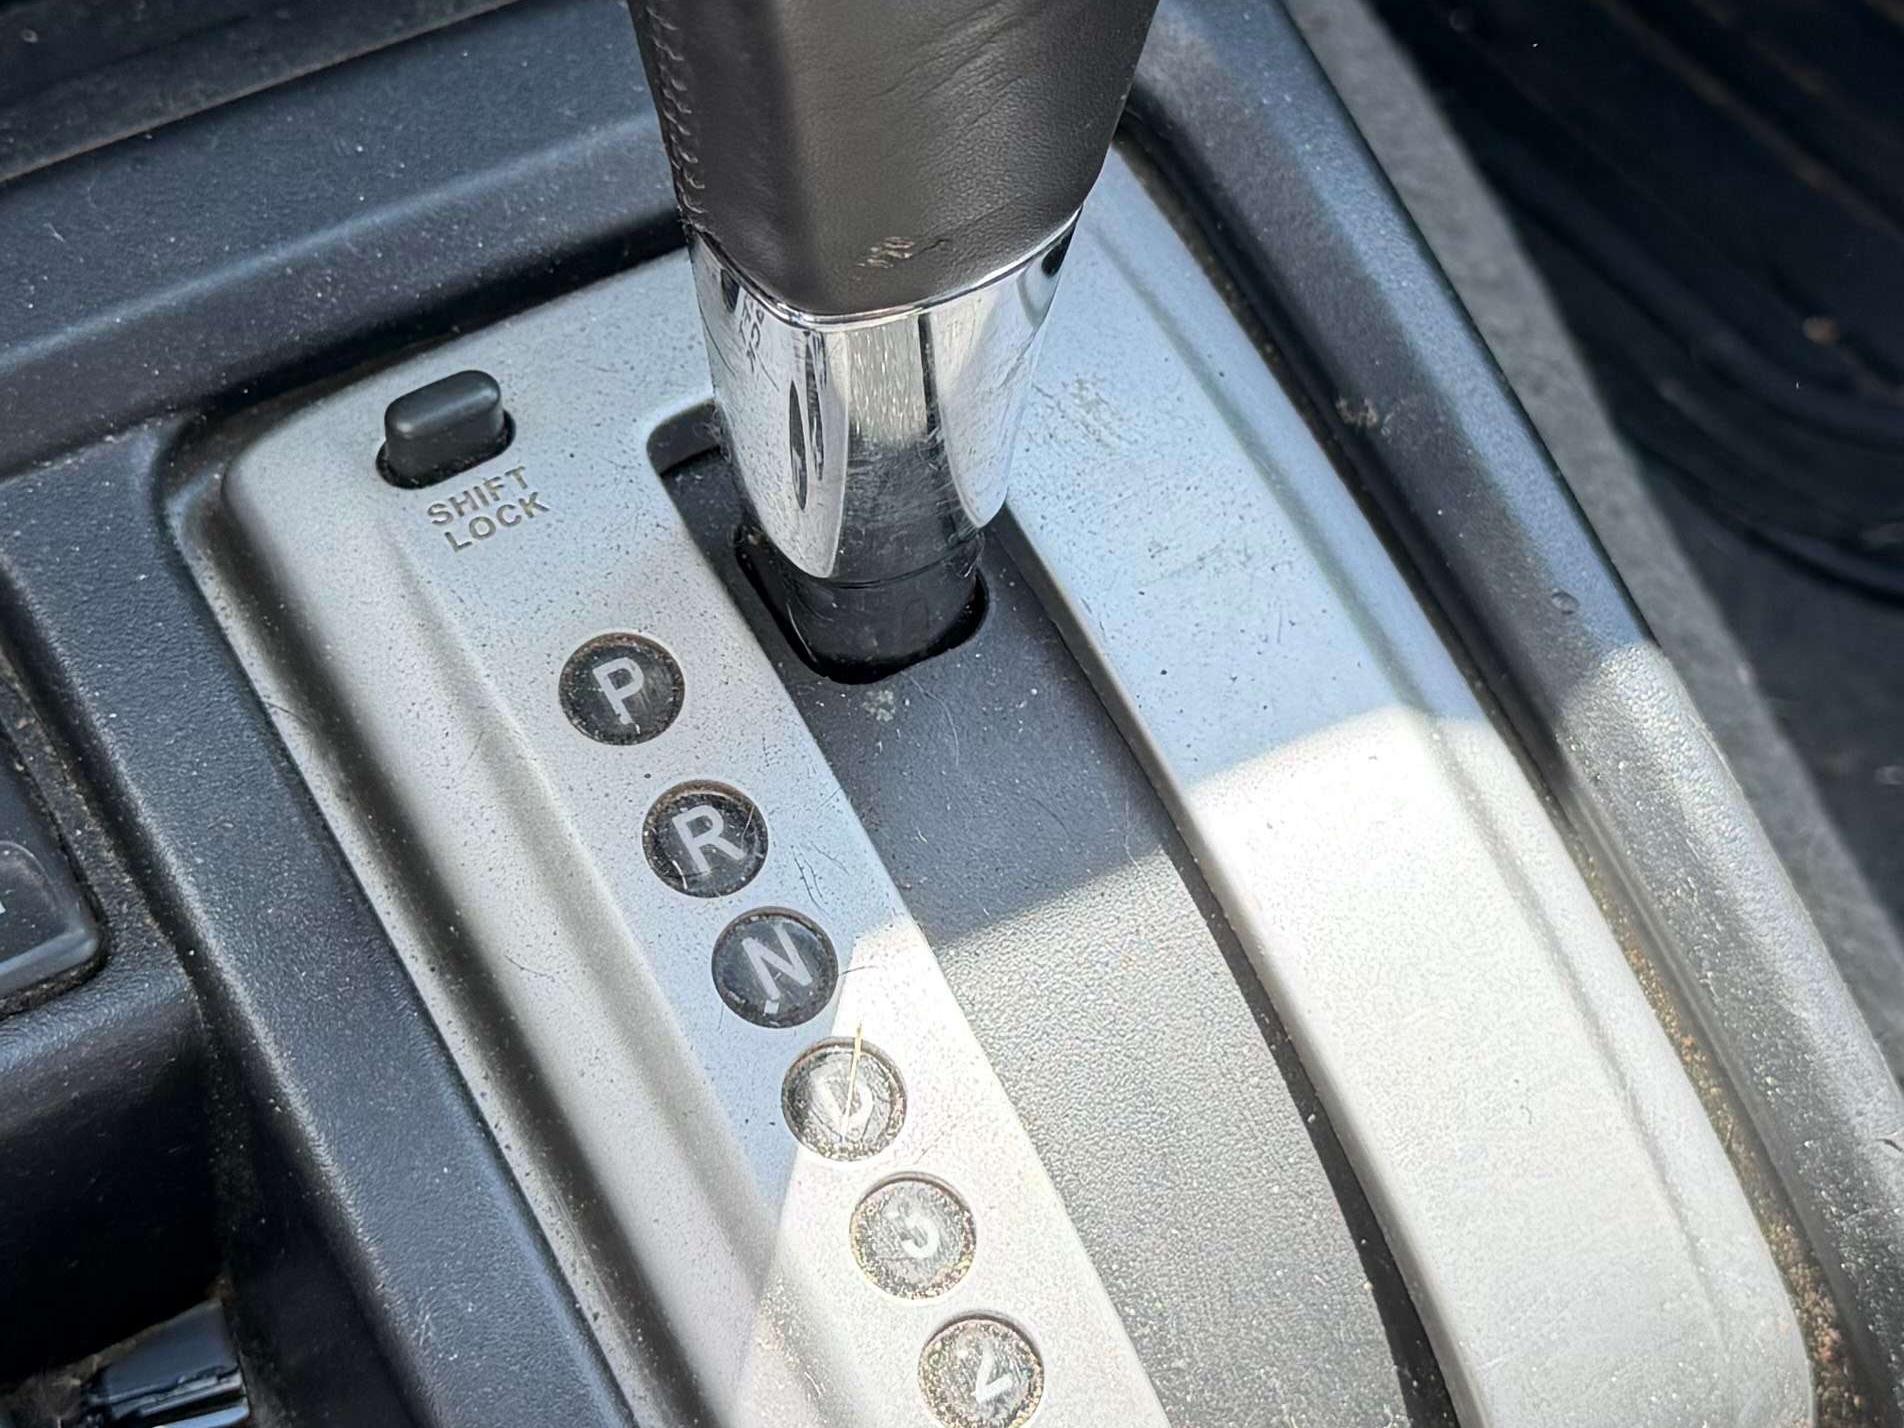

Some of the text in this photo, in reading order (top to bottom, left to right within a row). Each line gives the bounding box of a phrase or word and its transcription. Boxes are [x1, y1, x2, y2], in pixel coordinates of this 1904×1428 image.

[427, 466, 528, 525] SHIFT
[444, 492, 549, 552] LOCK
[592, 657, 645, 725] P
[673, 805, 746, 874] R
[741, 922, 813, 1000] N
[808, 1058, 874, 1136] D
